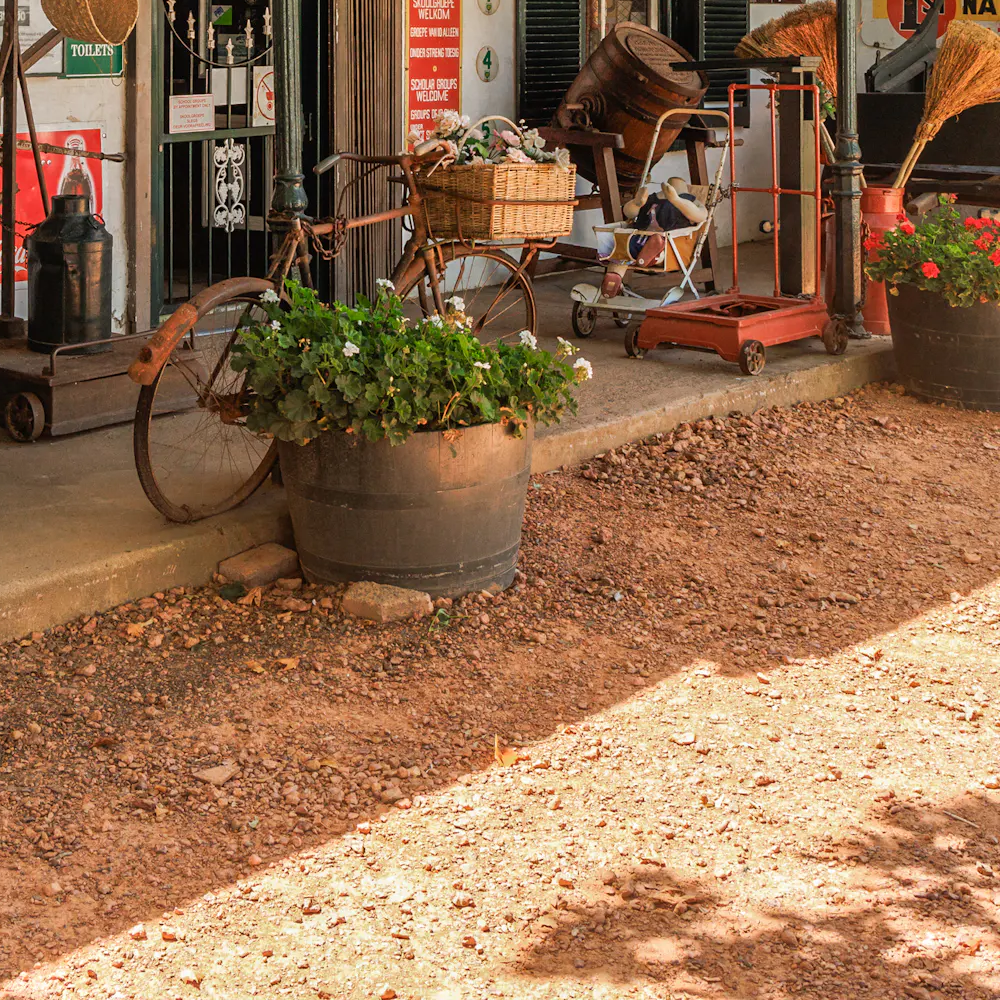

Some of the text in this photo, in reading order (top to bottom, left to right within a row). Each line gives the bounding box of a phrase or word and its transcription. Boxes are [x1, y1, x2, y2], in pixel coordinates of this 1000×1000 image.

[417, 8, 451, 20] WELKOM
[410, 26, 428, 38] GROEPE
[71, 43, 114, 57] TOILETS
[410, 47, 460, 58] ONDER STRENG TOESIG
[482, 50, 492, 70] 4
[410, 78, 458, 91] SCHOLAR GROUPS
[416, 90, 449, 102] WELCOME
[410, 109, 431, 120] GROUPS
